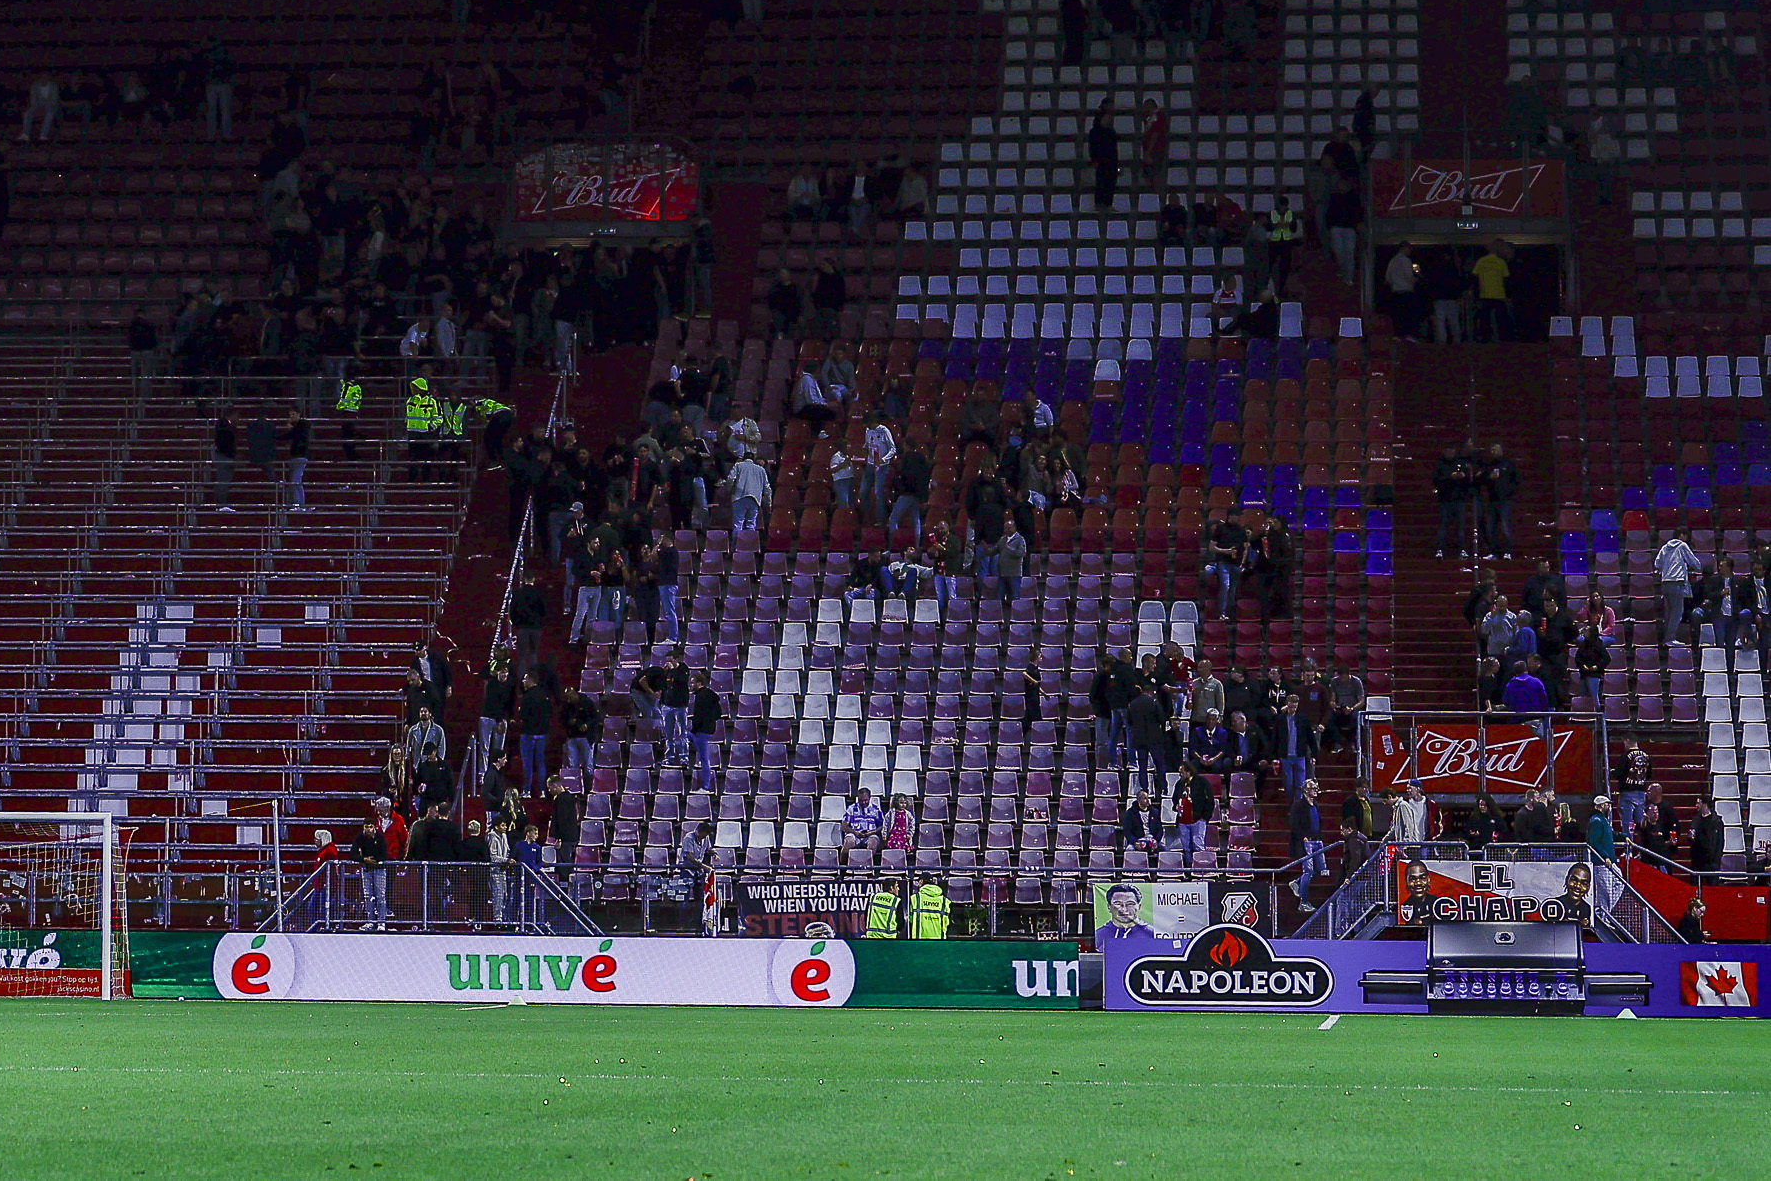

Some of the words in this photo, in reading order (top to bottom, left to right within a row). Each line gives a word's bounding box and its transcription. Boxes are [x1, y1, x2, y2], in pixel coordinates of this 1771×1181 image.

[558, 174, 643, 206] Bud
[1418, 170, 1508, 203] Bud
[1425, 737, 1527, 775] Bud
[747, 885, 780, 899] WHO
[783, 884, 826, 899] NEEDS
[829, 883, 884, 898] HAALAN
[1472, 862, 1515, 893] EL
[763, 899, 806, 914] WHEN
[808, 898, 839, 912] YOU
[840, 897, 869, 912] HAV
[1157, 892, 1204, 906] MICHAEL
[1229, 896, 1255, 924] TRECHT
[1432, 894, 1566, 922] CHAPO
[445, 939, 617, 993] univé
[1141, 970, 1317, 994] NAPOLEON
